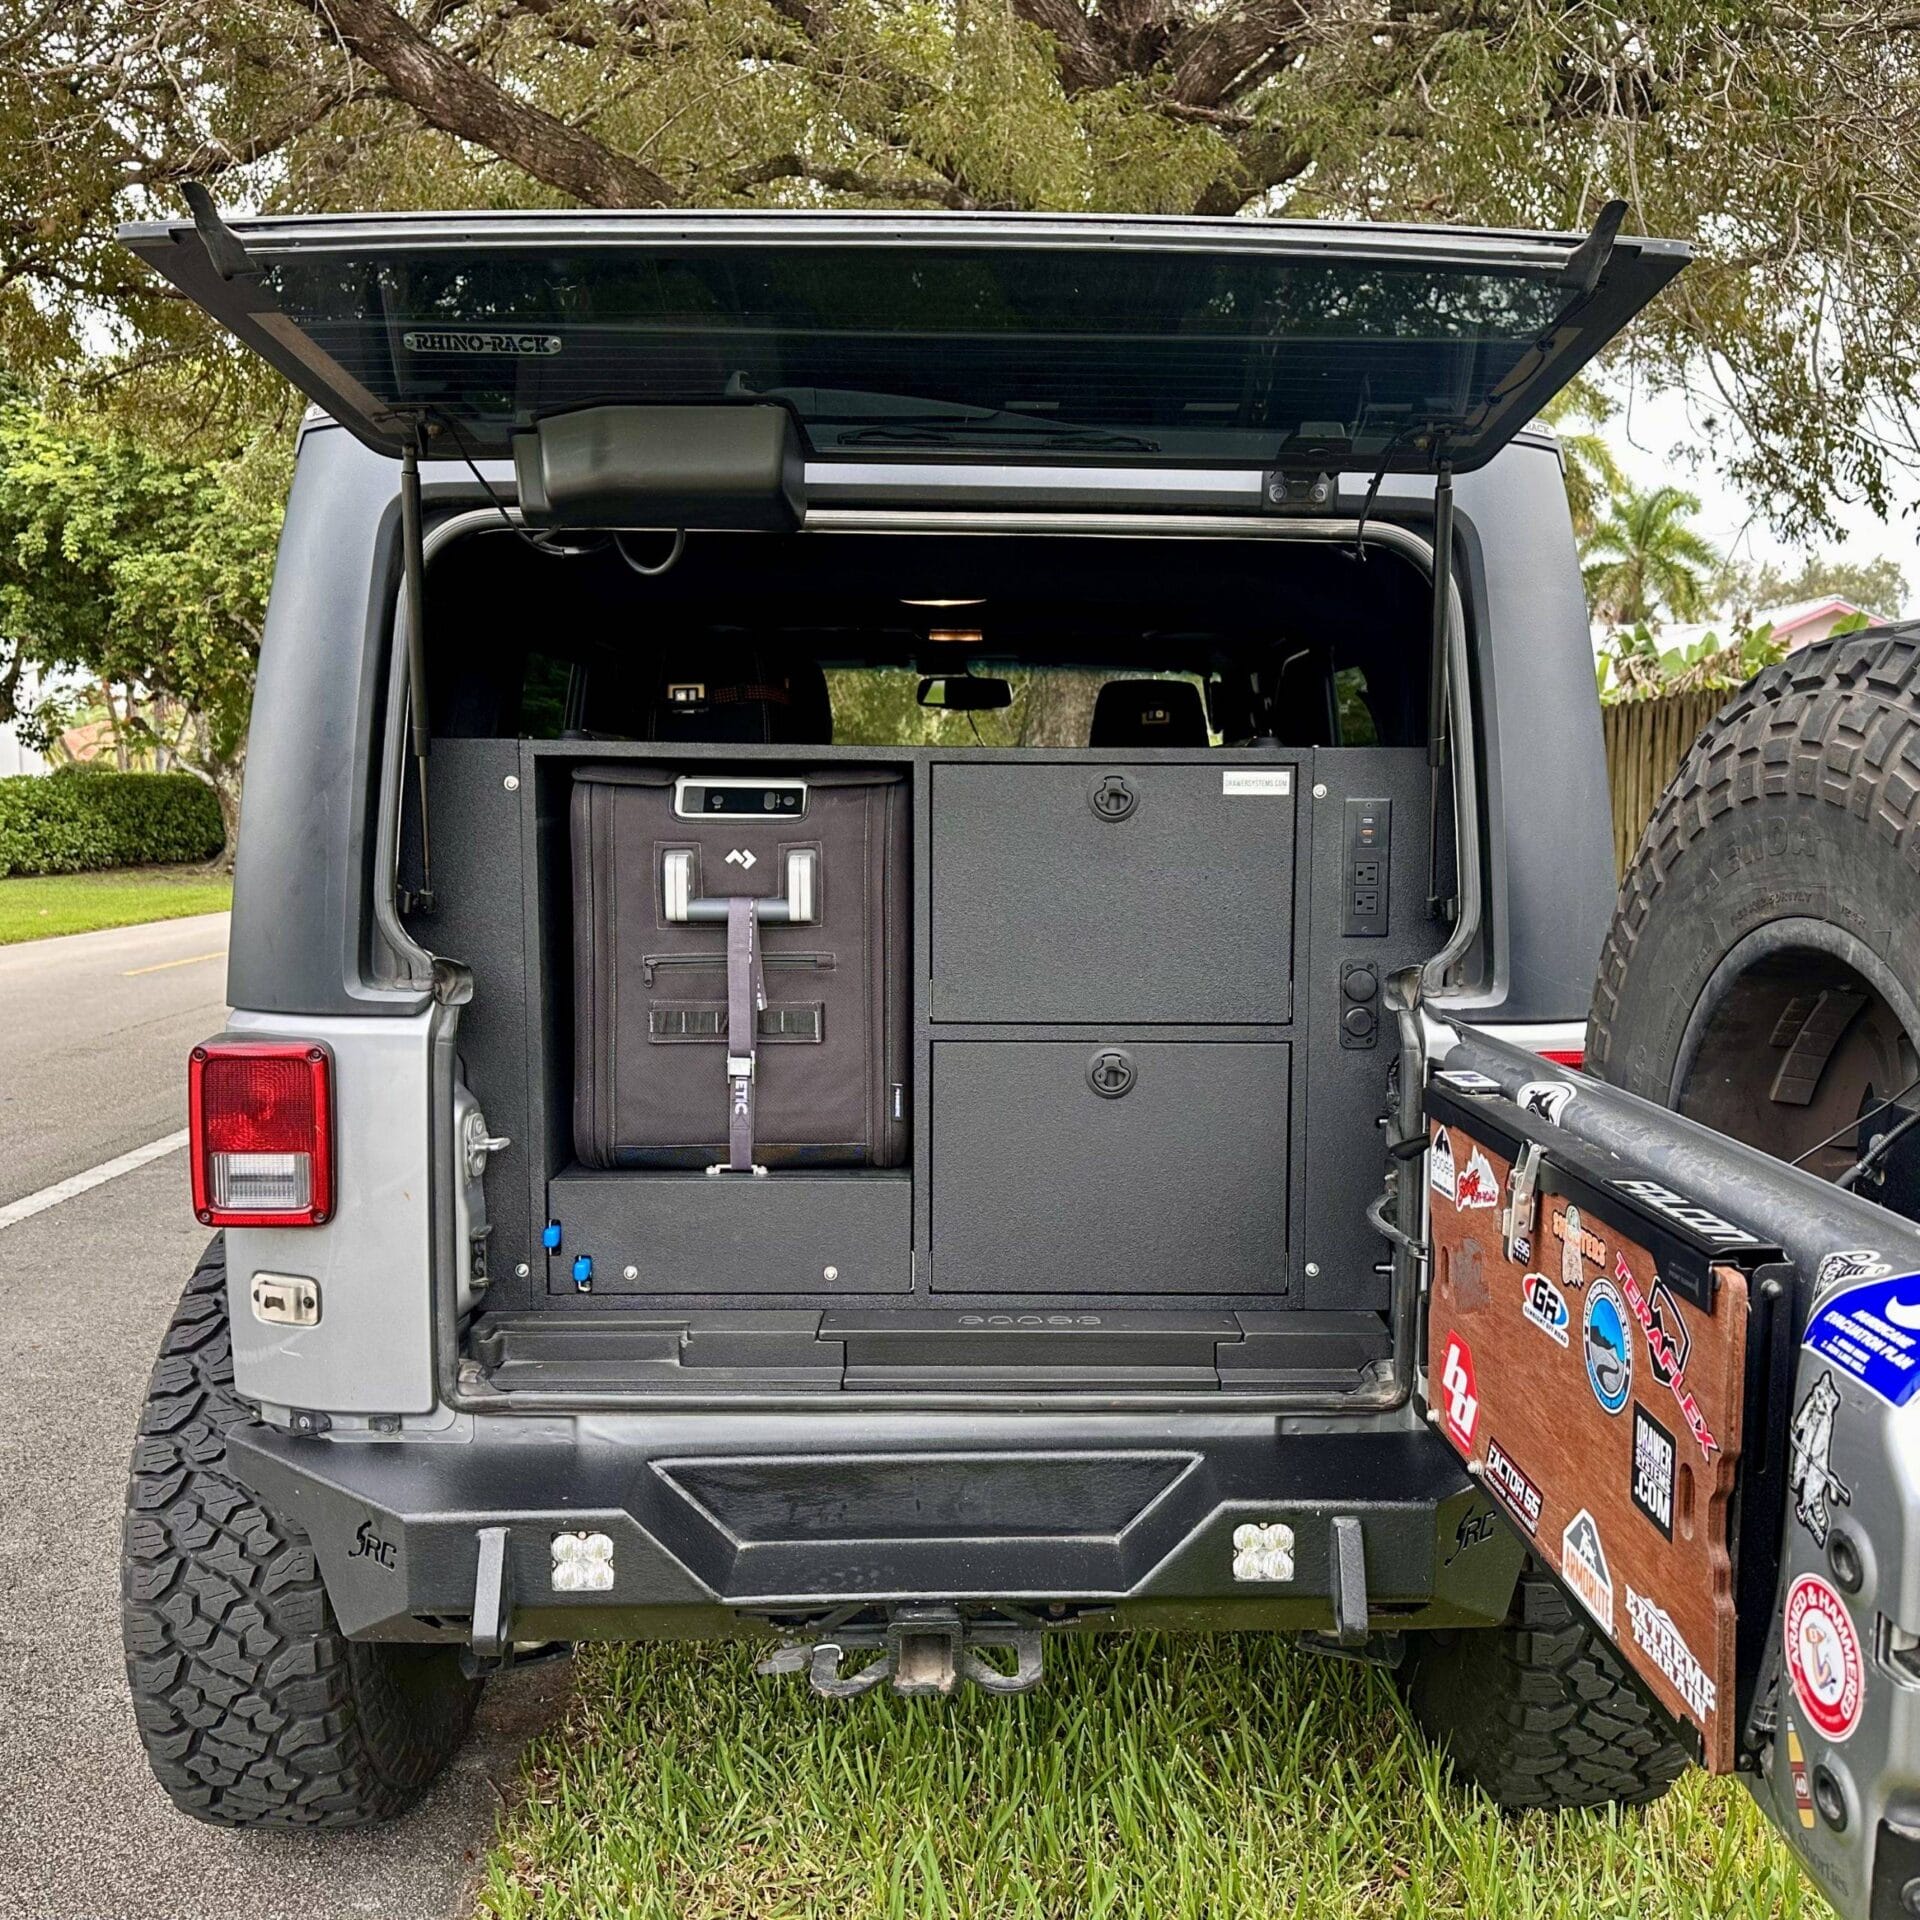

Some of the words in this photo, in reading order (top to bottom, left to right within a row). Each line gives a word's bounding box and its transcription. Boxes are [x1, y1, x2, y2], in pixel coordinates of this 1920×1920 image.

[414, 334, 549, 353] RHINO-RACK
[735, 1076, 748, 1115] ETIC
[1612, 1180, 1759, 1242] FALCON
[1615, 1251, 1719, 1462] TERAFLEX
[1823, 1310, 1887, 1352] EVACUATION
[1879, 1345, 1915, 1370] PLAN
[1851, 1309, 1916, 1349] HURRICANE
[1635, 1447, 1671, 1493] SYSTEMS
[1636, 1415, 1672, 1478] DRAWER
[1487, 1444, 1525, 1501] FACTOR
[1524, 1487, 1541, 1519] 55
[1634, 1471, 1670, 1528] .COM
[1566, 1546, 1610, 1626] ARMORLITE
[1625, 1584, 1716, 1711] EXTREME
[1632, 1618, 1707, 1723] TERRAIN
[1790, 1590, 1807, 1666] ARMED
[1806, 1585, 1817, 1606] &
[1819, 1590, 1858, 1721] HAMMERED
